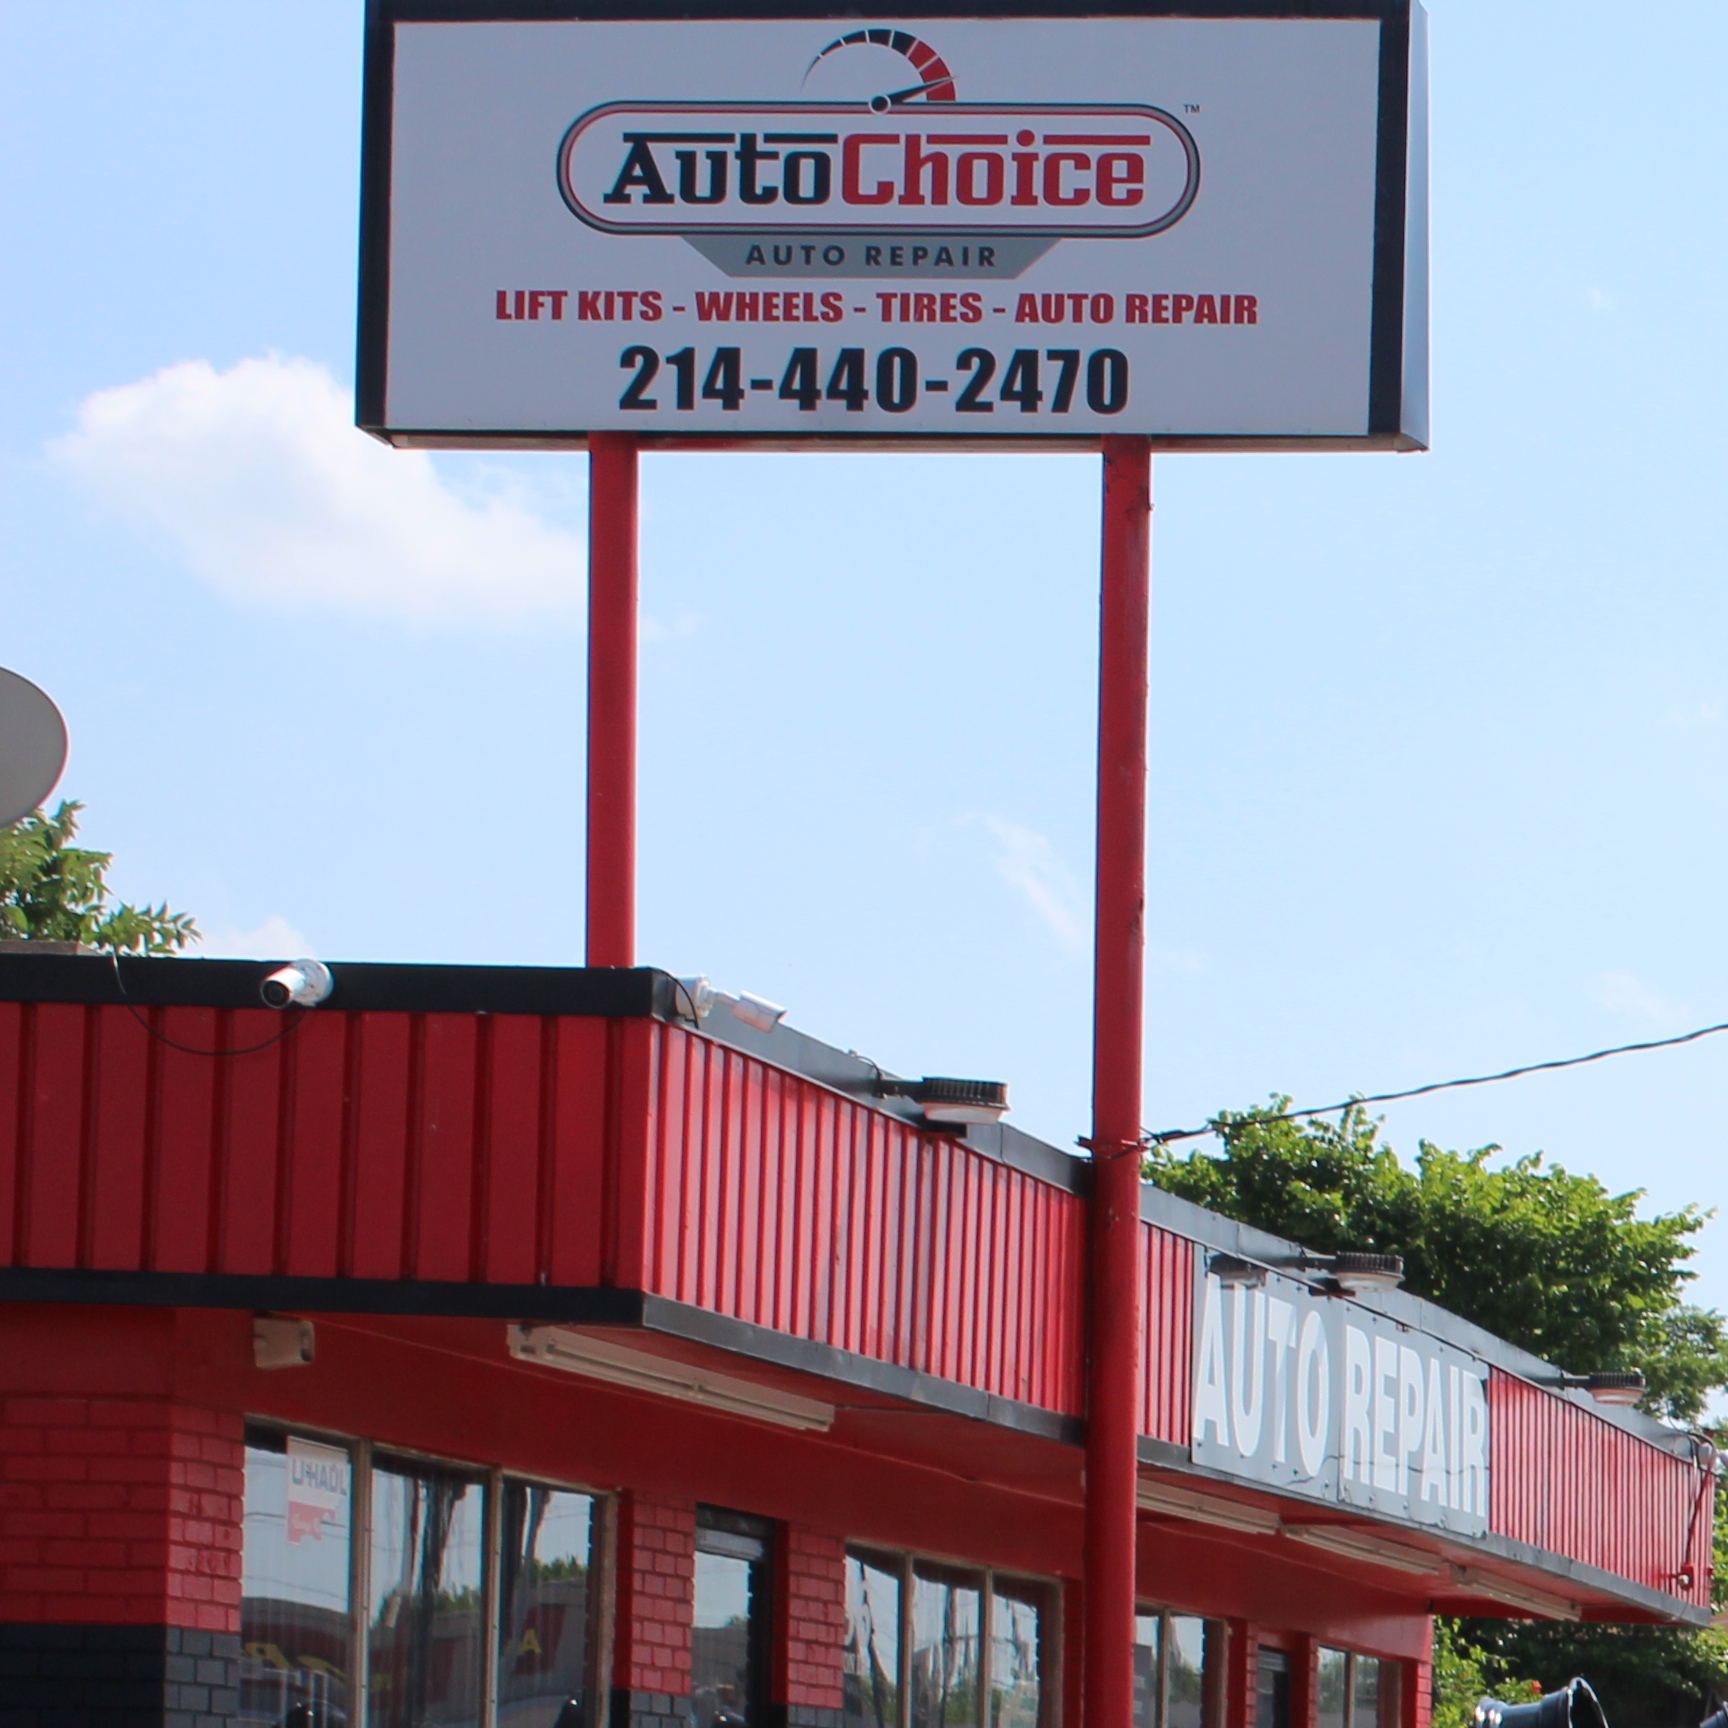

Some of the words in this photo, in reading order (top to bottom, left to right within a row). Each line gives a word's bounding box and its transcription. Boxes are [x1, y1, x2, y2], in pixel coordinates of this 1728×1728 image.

[602, 129, 1151, 207] AutoChoice
[745, 244, 845, 266] AUTO
[864, 245, 996, 268] REPAIR
[495, 289, 568, 321] LIFT
[577, 290, 663, 321] KITS
[694, 291, 844, 323] WHEELS
[875, 292, 983, 323] TIRES
[1014, 293, 1115, 325] AUTO
[1124, 293, 1259, 326] REPAIR
[618, 345, 1130, 415] 214-440-2470
[1192, 1272, 1330, 1478] AUTO
[1344, 1323, 1488, 1518] REPAIR
